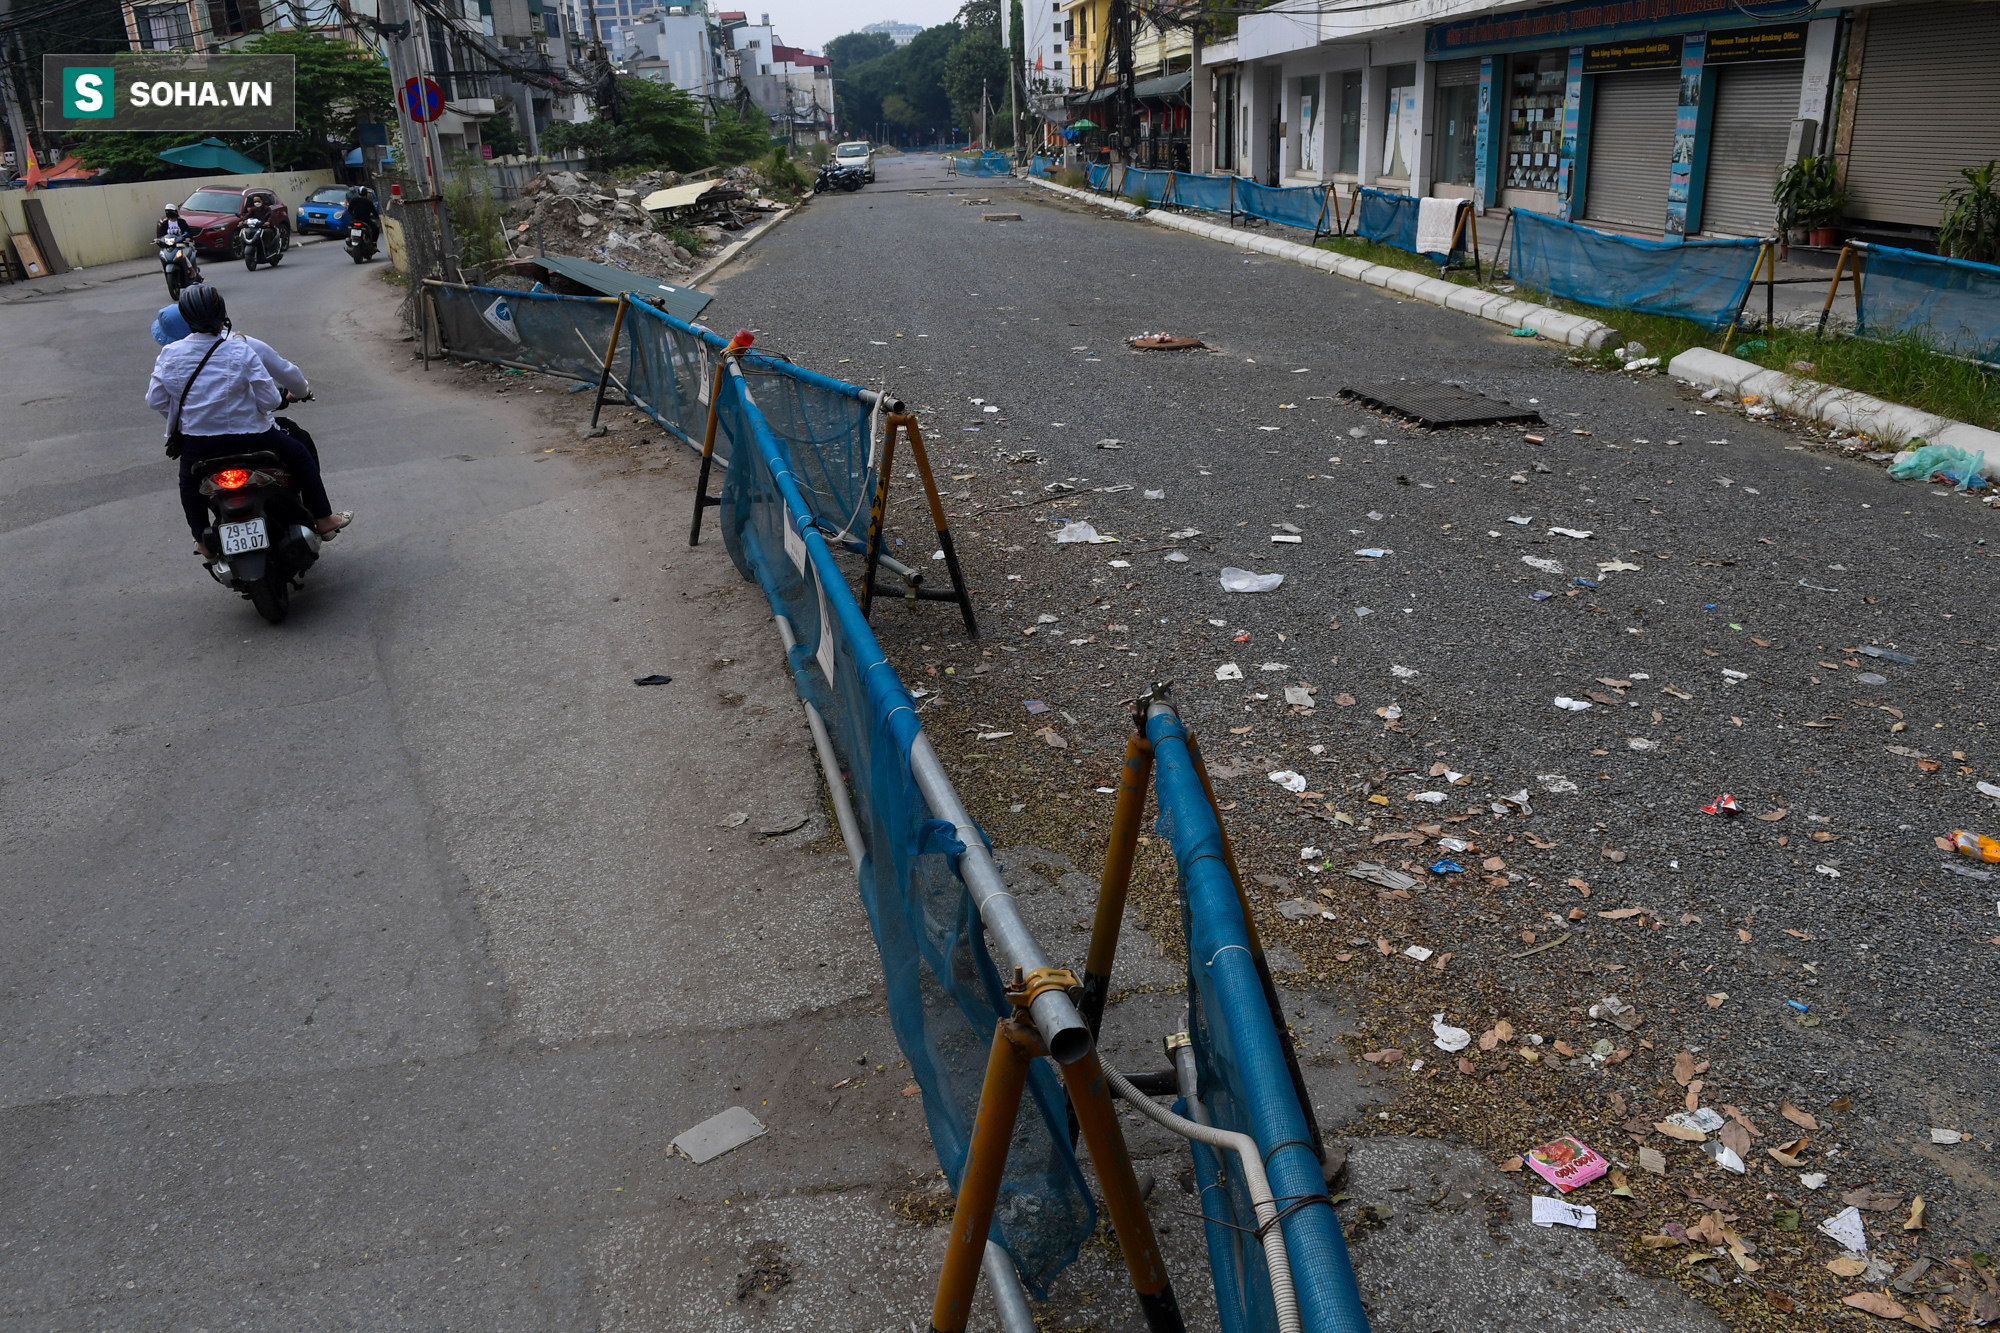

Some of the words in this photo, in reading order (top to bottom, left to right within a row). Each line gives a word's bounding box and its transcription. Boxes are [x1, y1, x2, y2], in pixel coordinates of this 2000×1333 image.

[1511, 11, 1531, 37] TRIỂN
[1531, 12, 1551, 35] NHÂN
[1570, 6, 1602, 30] THƯƠNG
[1602, 4, 1620, 29] MẠI
[1621, 0, 1633, 22] VÀ
[1634, 0, 1648, 20] DU
[1648, 0, 1671, 22] LỊCH
[1749, 35, 1760, 43] And
[1761, 33, 1782, 42] Booking
[1783, 32, 1799, 40] Office
[1646, 44, 1657, 53] Gold
[1657, 43, 1669, 52] Gifts
[226, 522, 259, 539] 29-E2
[226, 535, 264, 553] 438.07
